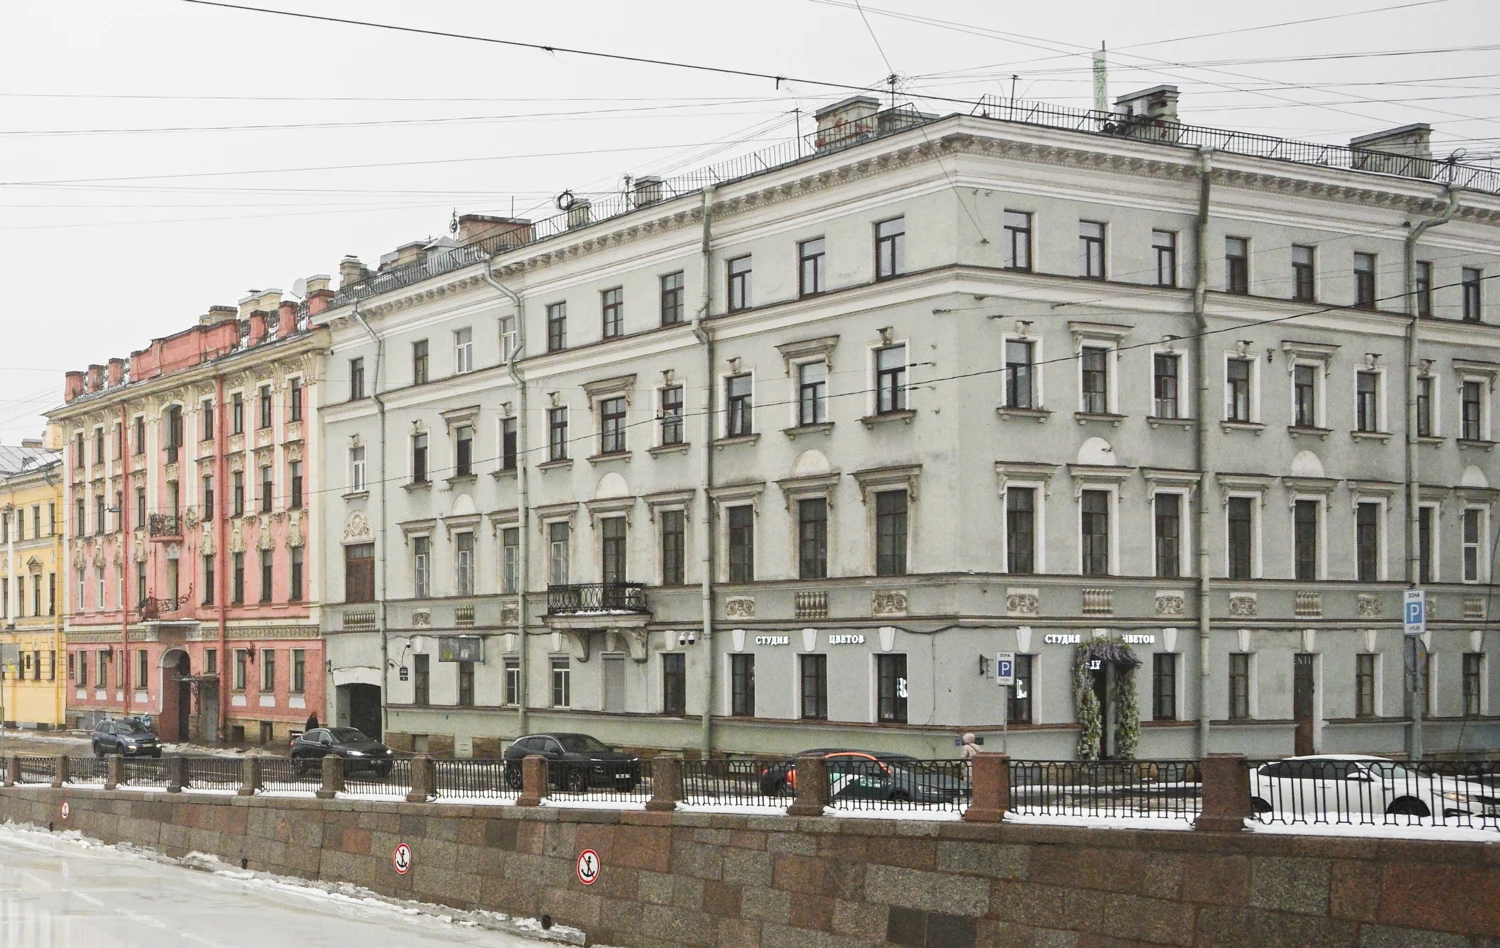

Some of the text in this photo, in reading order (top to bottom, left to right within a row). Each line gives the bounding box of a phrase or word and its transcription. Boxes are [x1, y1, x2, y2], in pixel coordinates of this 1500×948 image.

[1410, 604, 1420, 622] P
[755, 634, 865, 646] СТУДИЯ ЦВЕТОВ
[1044, 634, 1081, 645] СТУДИЯ
[1001, 662, 1010, 676] P
